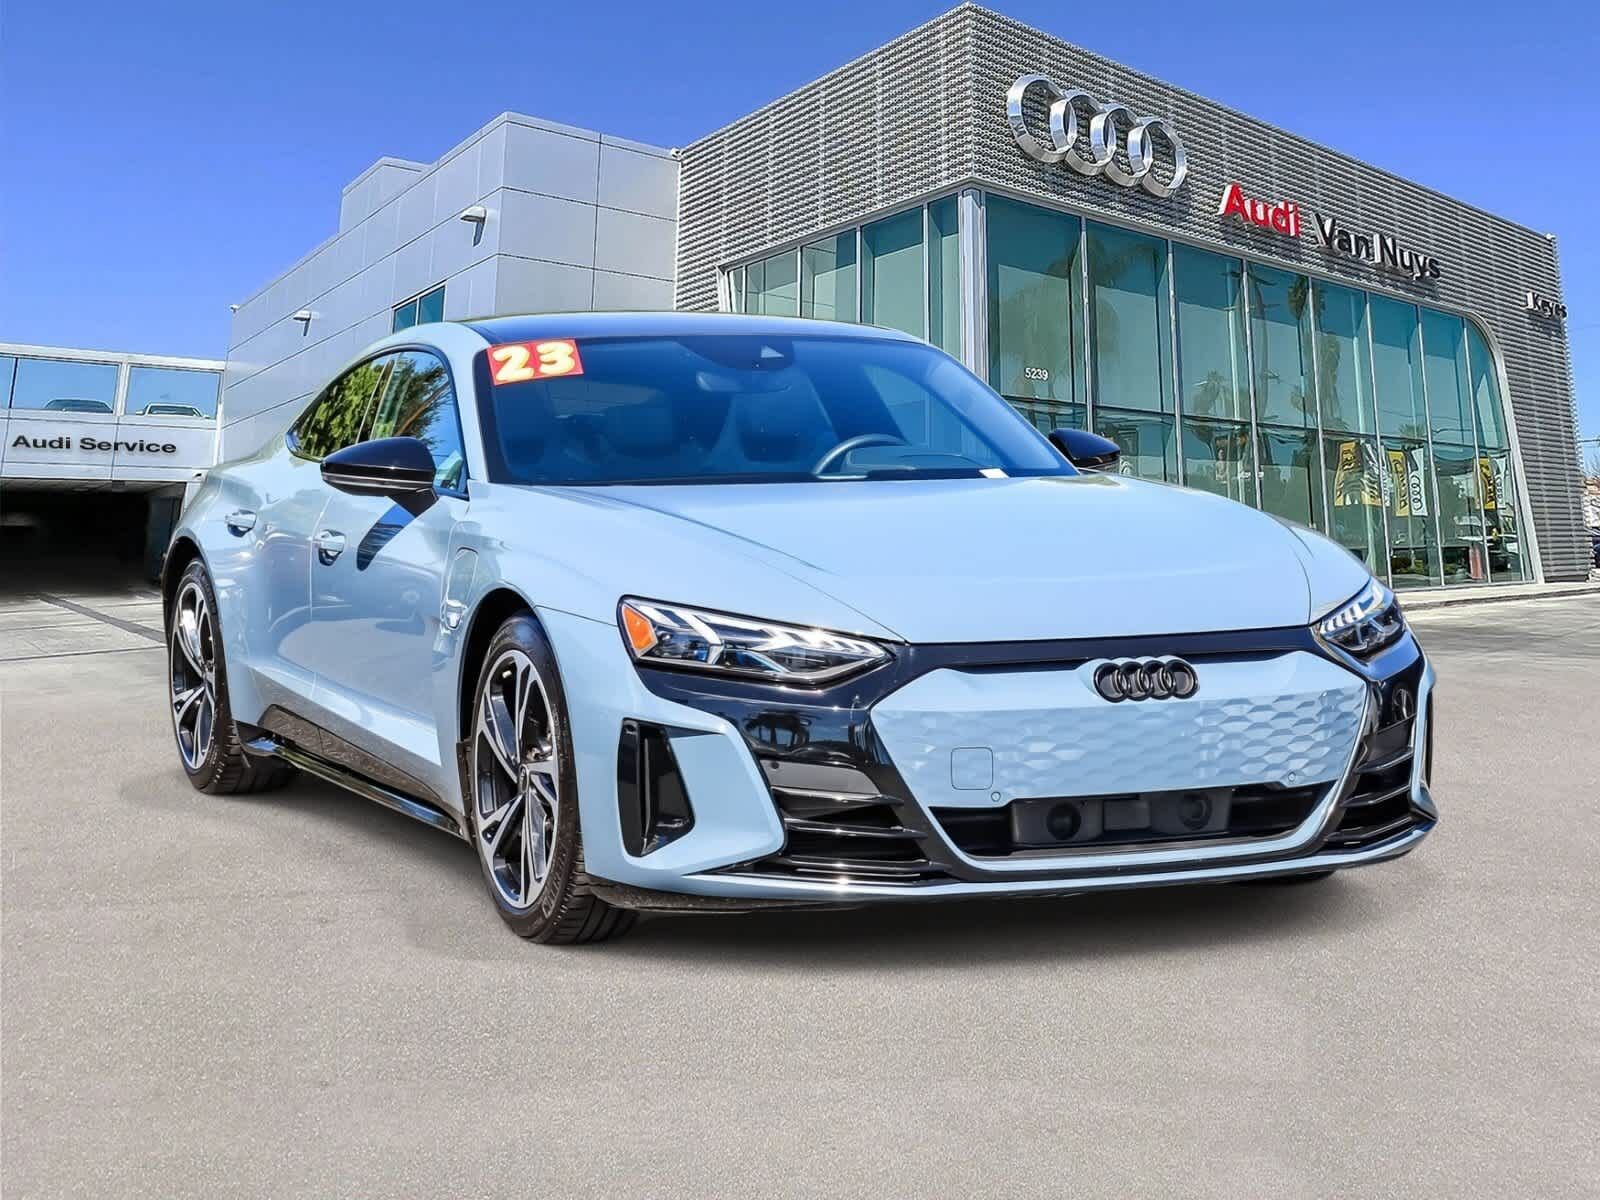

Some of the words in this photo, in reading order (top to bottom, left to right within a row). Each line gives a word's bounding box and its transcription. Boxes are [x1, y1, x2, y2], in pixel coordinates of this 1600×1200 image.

[1219, 181, 1301, 236] Audi
[1313, 213, 1371, 258] Van
[1373, 233, 1442, 280] Nuys
[493, 341, 576, 381] 23
[1025, 367, 1049, 380] 5239
[12, 434, 71, 450] Audi
[79, 437, 177, 454] Service
